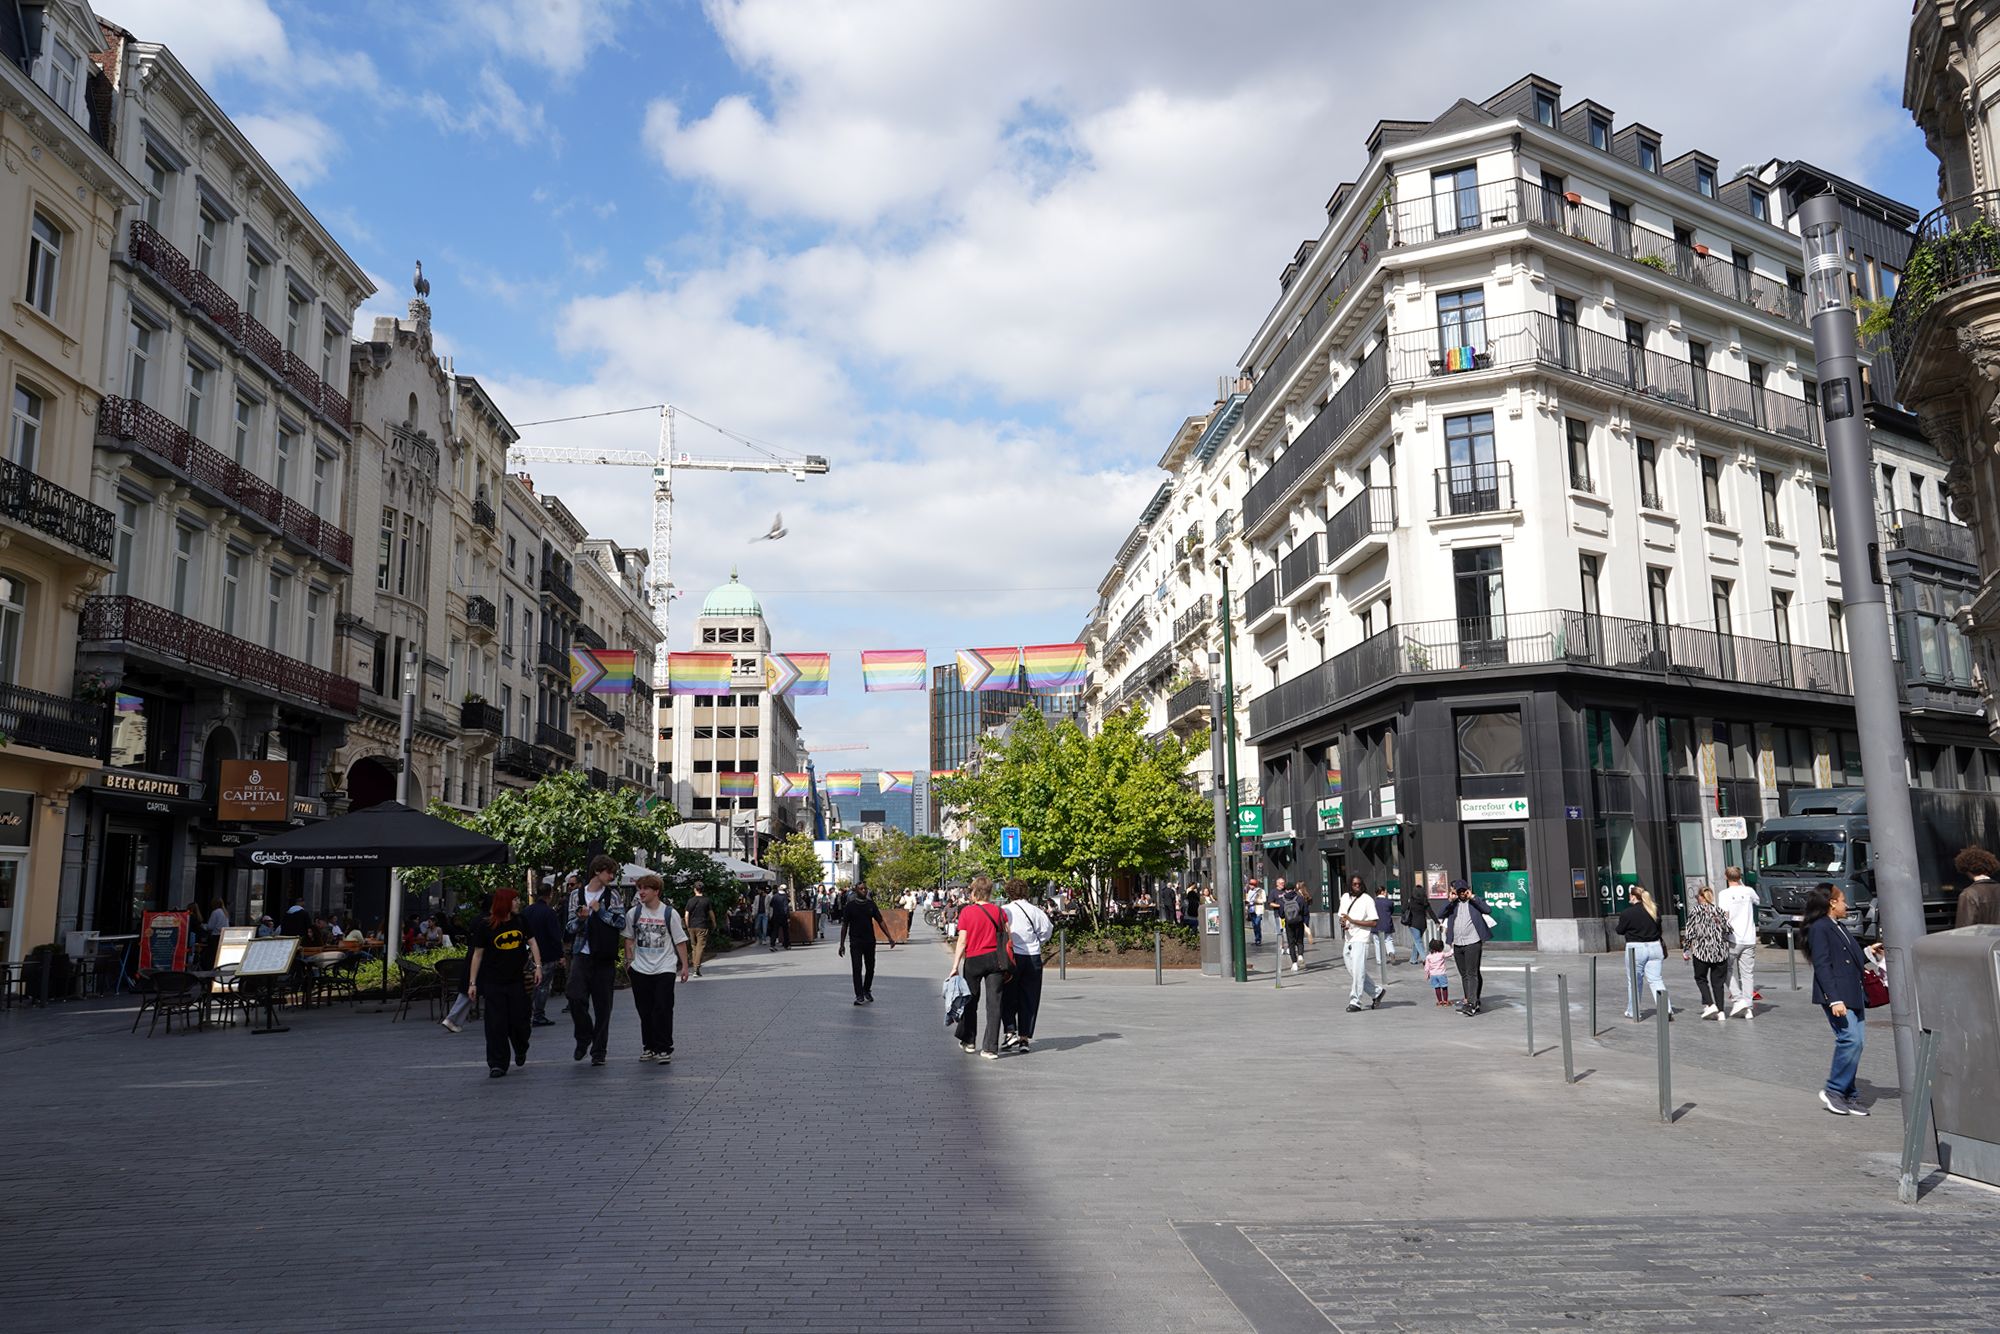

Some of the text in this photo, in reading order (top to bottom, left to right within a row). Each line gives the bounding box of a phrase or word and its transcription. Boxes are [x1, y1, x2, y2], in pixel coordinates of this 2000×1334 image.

[106, 775, 179, 796] BEER CAPITAL
[223, 791, 285, 801] CAPITAL
[146, 801, 170, 813] CAPITAL
[293, 801, 313, 814] PITAL
[1462, 802, 1506, 811] Carrefour
[221, 833, 241, 844] CAPITAL
[251, 850, 293, 866] Carlsberg
[1484, 890, 1516, 901] Ingang
